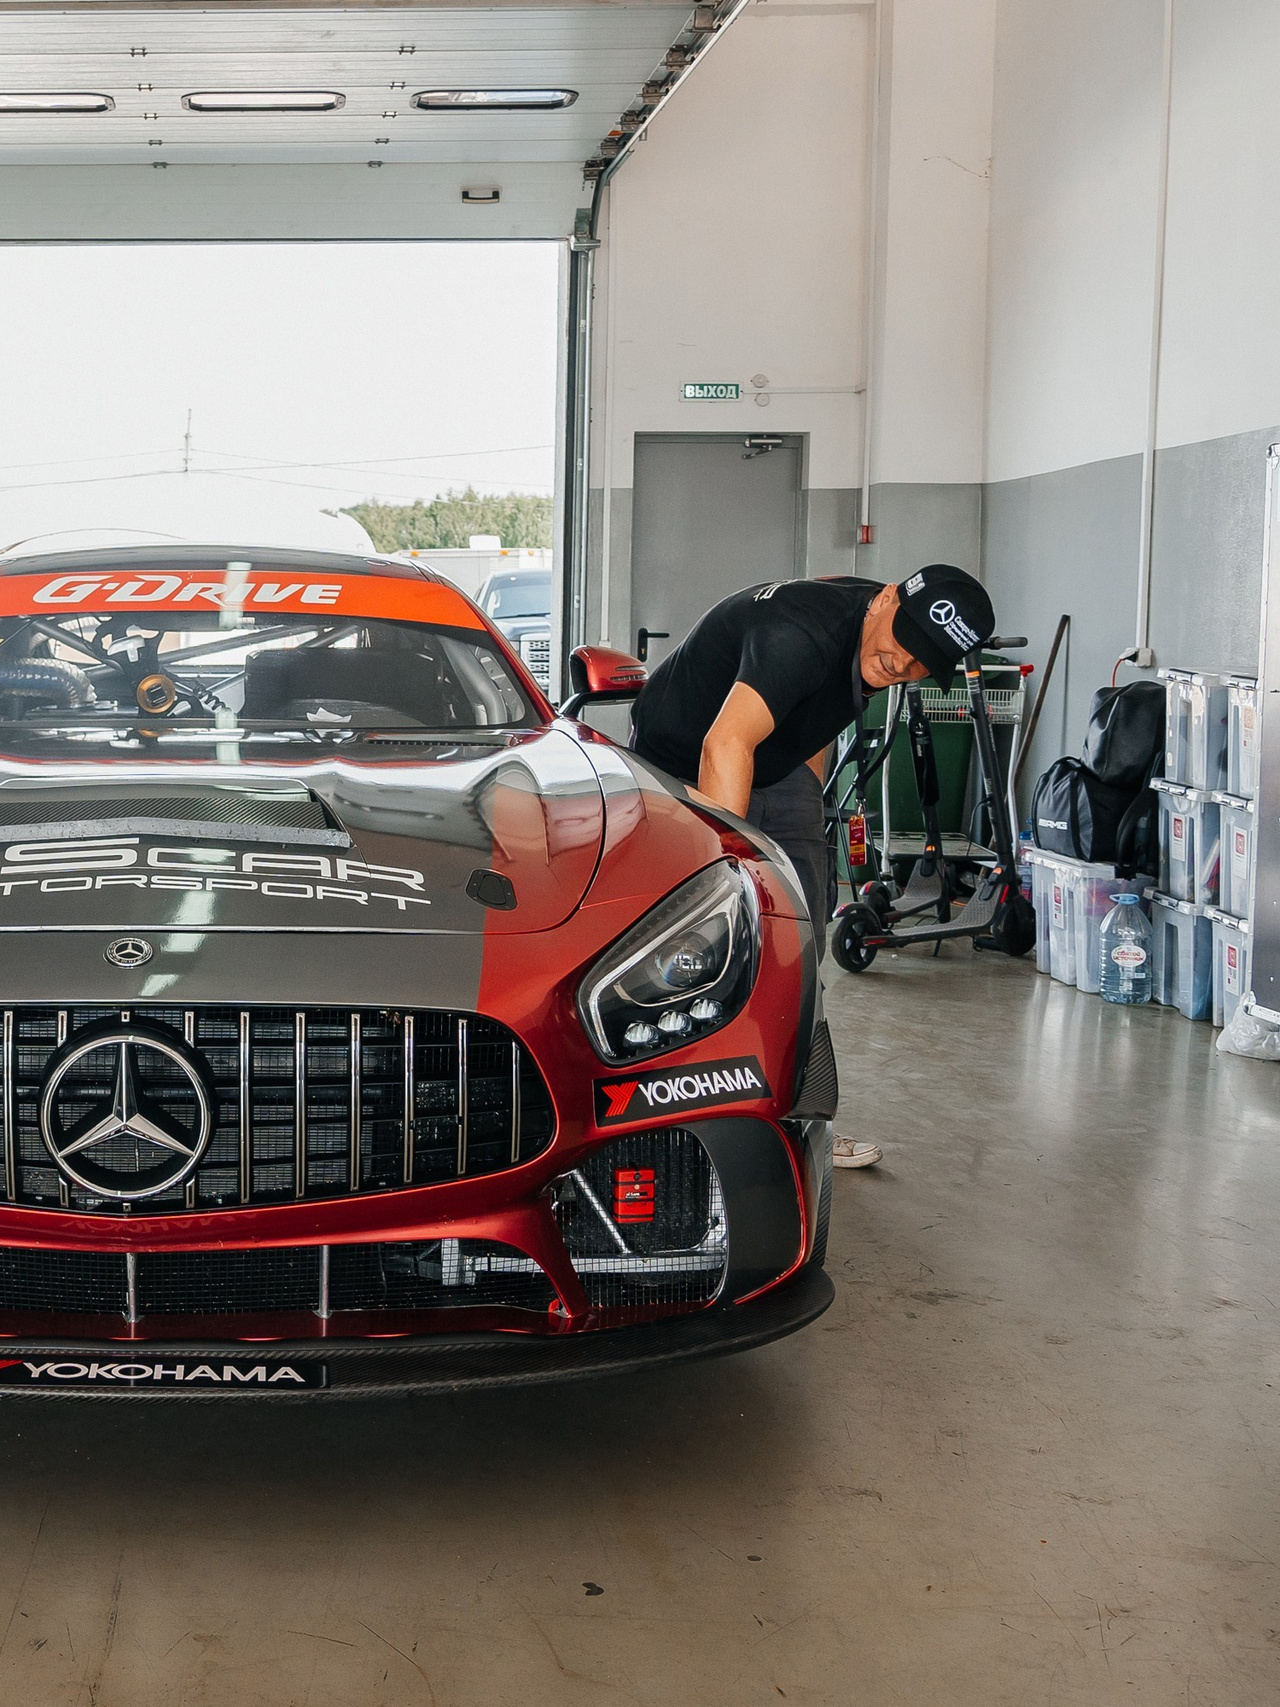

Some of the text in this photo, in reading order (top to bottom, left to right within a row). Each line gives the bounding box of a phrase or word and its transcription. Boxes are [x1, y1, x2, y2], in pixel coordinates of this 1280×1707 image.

[685, 385, 737, 399] ВЫХОД
[638, 1066, 763, 1106] YOKOHAMA
[23, 1362, 306, 1383] YOKOHAMA
